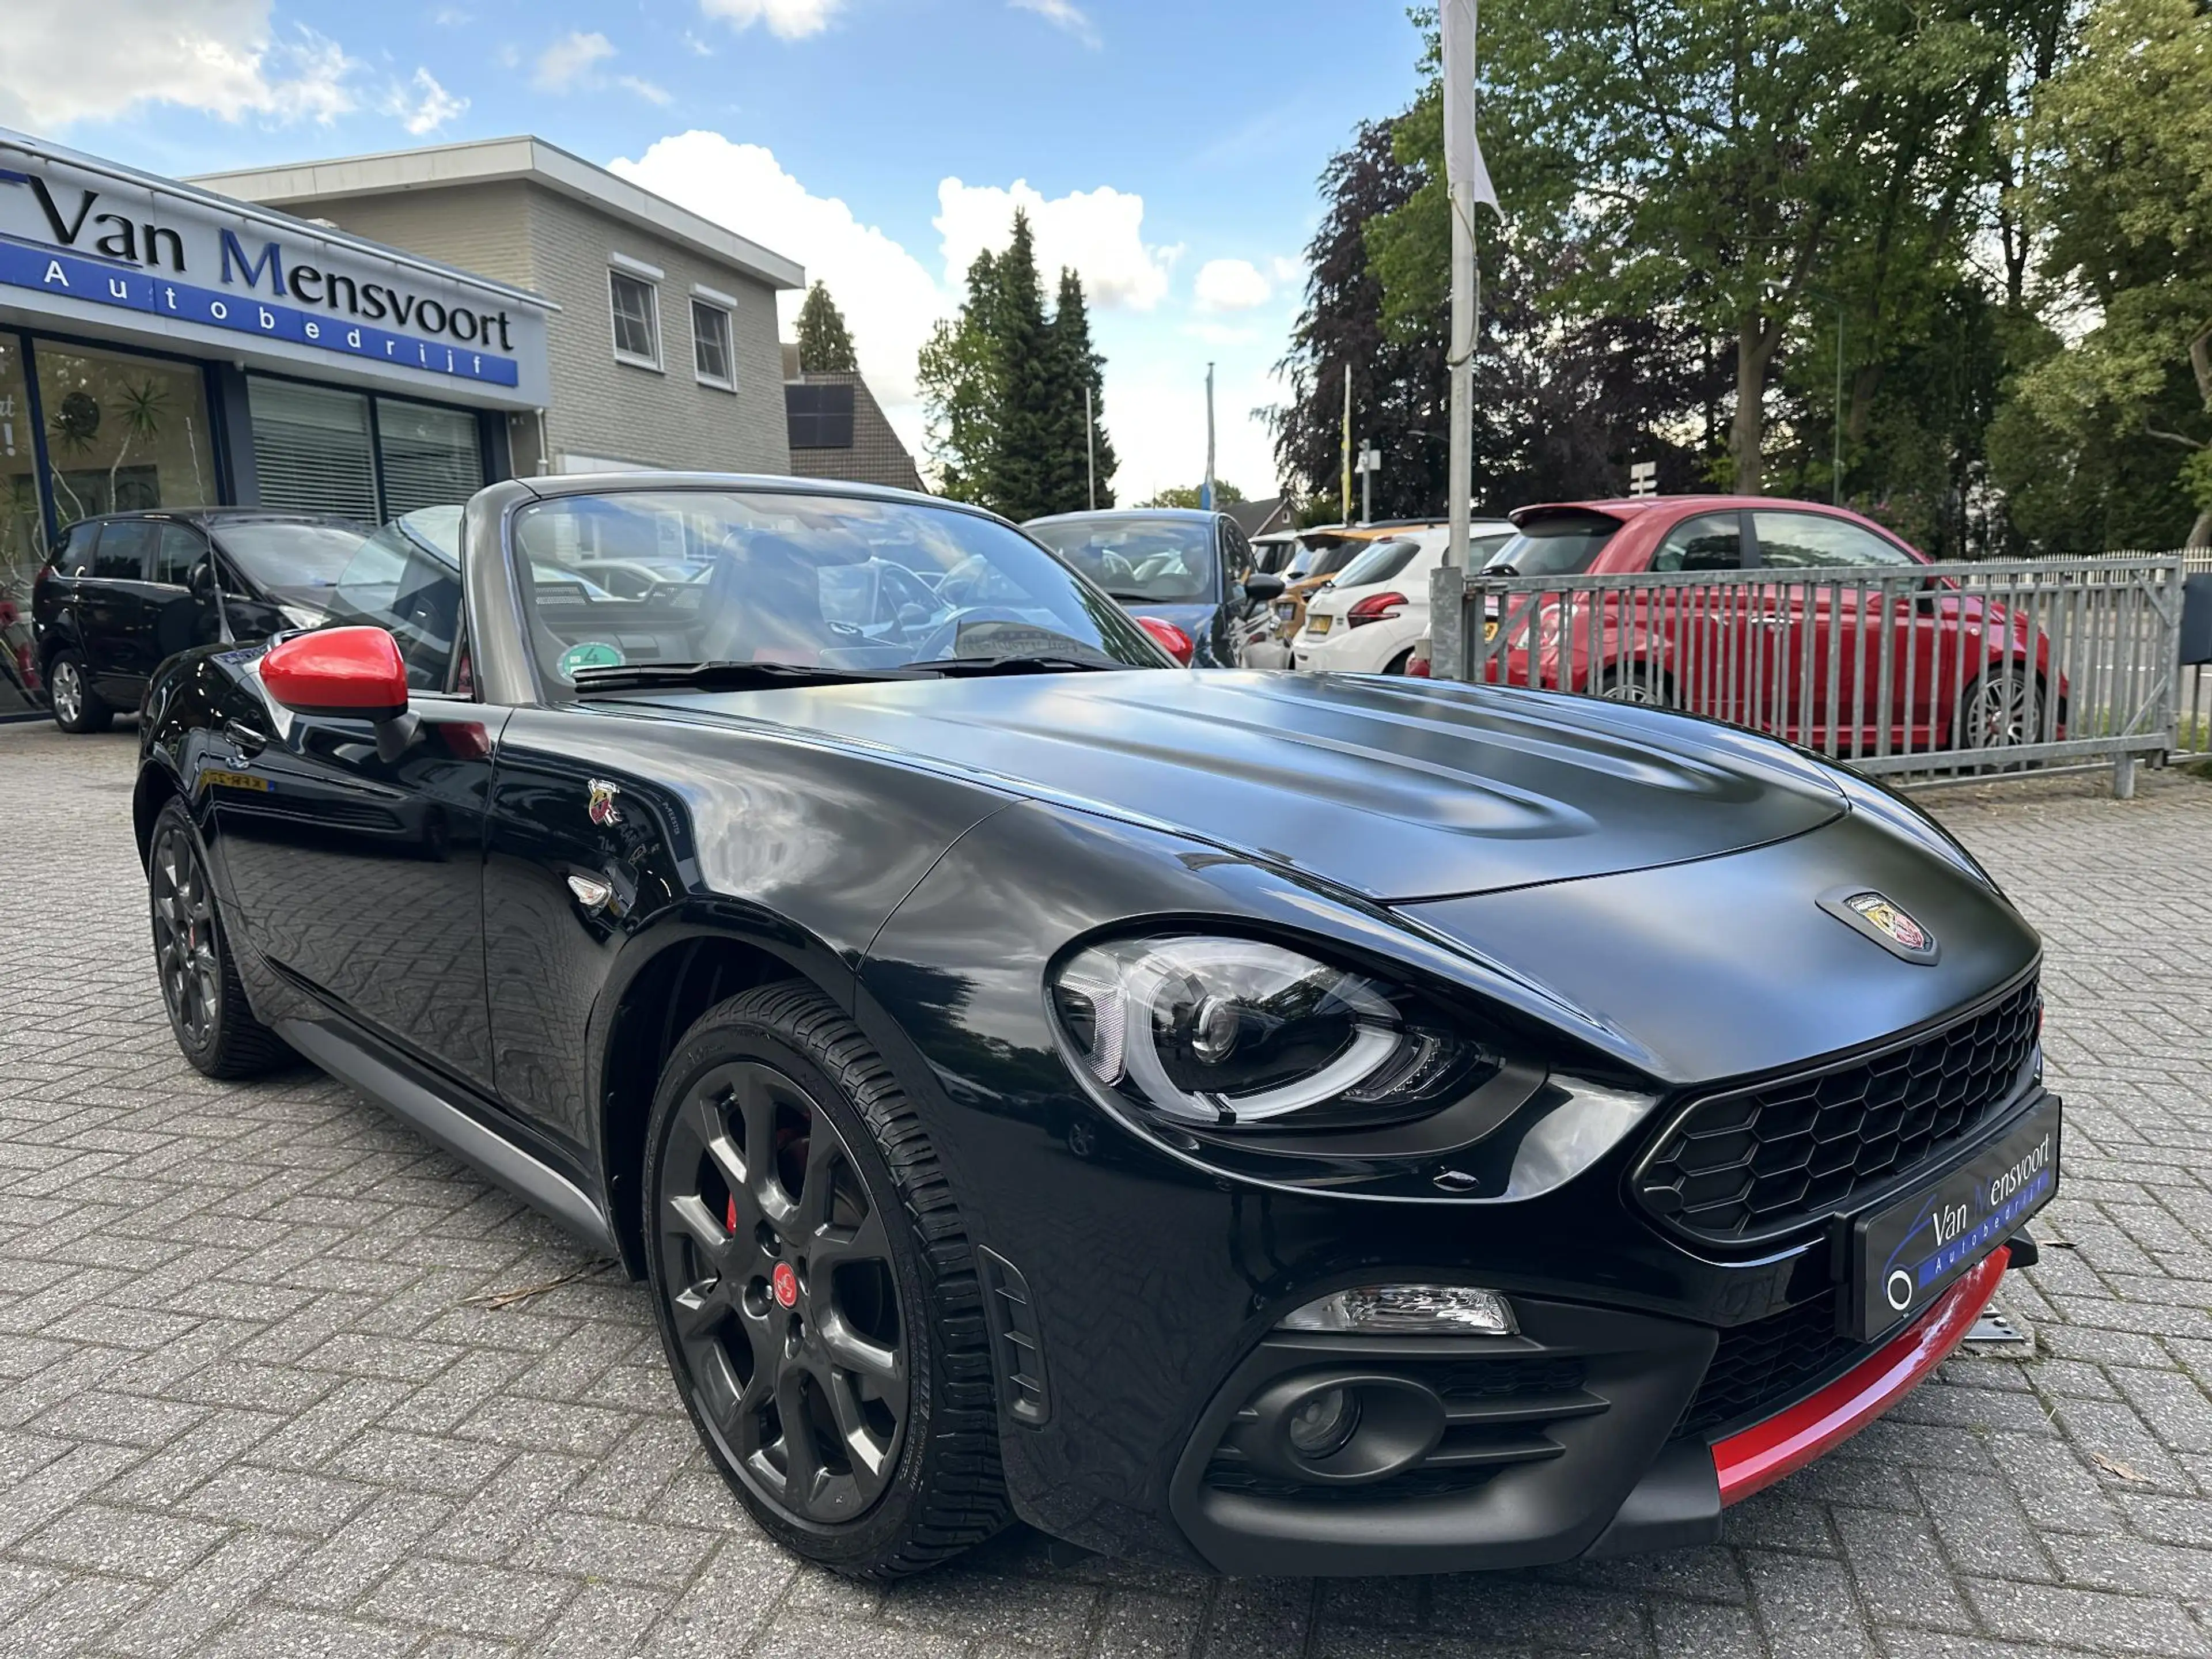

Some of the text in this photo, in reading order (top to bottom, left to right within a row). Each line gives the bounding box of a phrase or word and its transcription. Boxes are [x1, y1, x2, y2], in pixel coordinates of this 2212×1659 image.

[26, 173, 514, 352] Van Mensvoort
[44, 260, 482, 374] Autobedrijf
[584, 647, 600, 664] 4
[1933, 1132, 2050, 1247] Van Mensvoort
[1936, 1177, 2042, 1274] Autobedrijf
